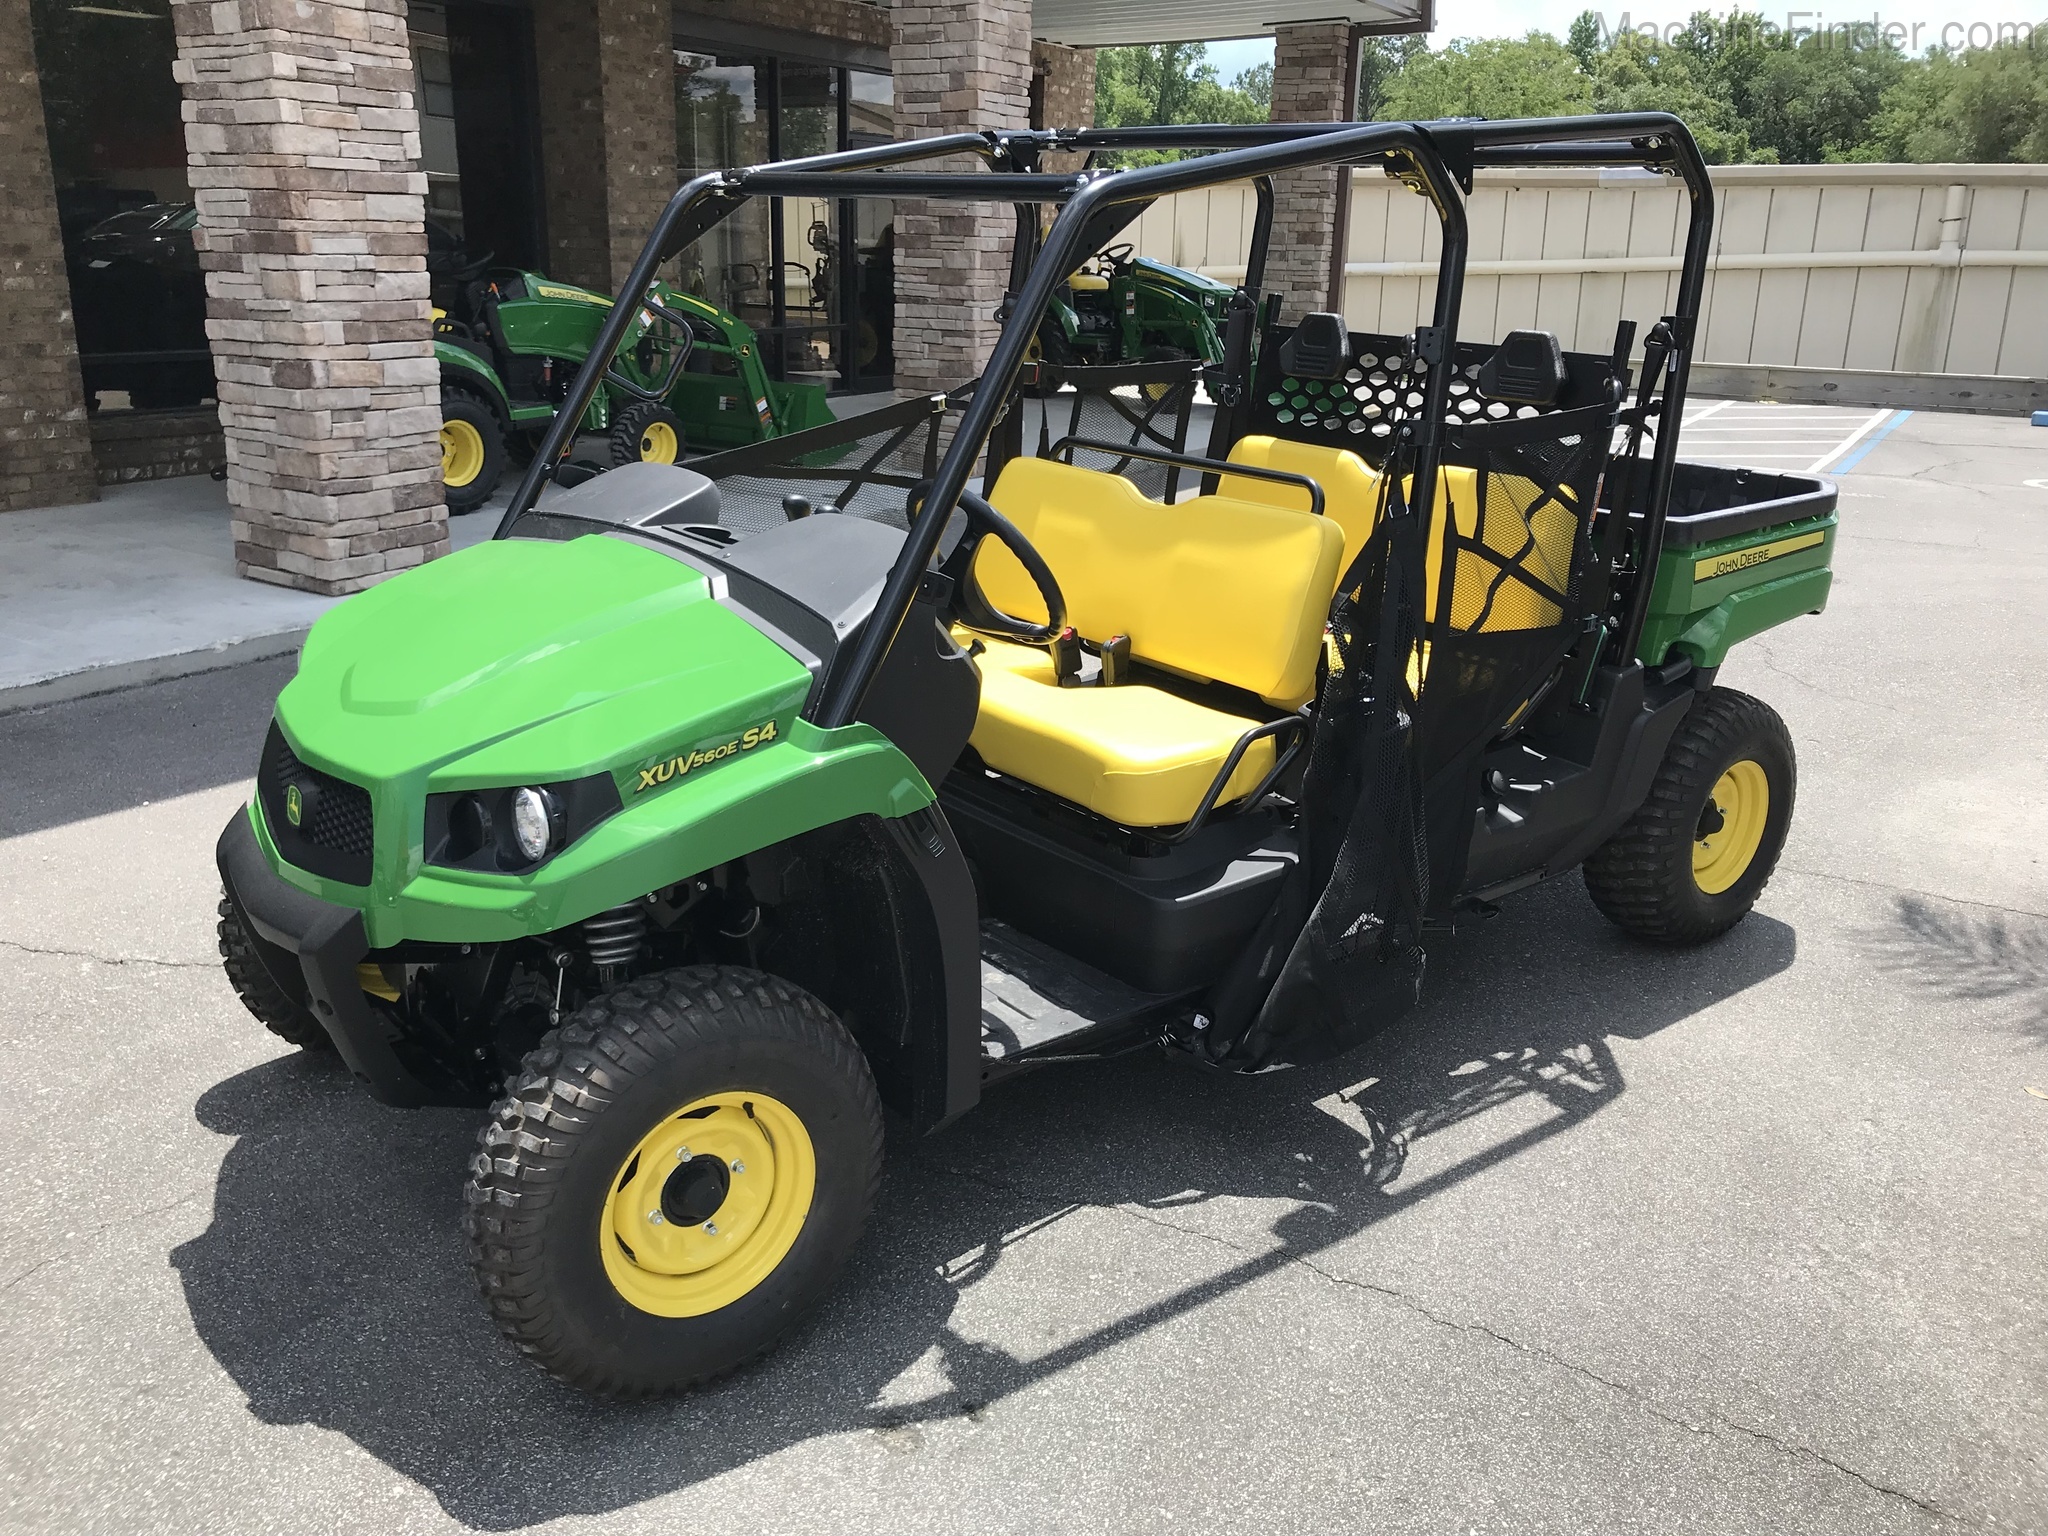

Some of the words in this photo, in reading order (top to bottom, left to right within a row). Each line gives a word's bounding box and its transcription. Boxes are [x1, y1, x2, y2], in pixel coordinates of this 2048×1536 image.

[1713, 557, 1739, 575] JOHN
[1740, 549, 1770, 567] DEERE
[635, 739, 739, 793] XUV560E
[742, 720, 778, 751] S4
